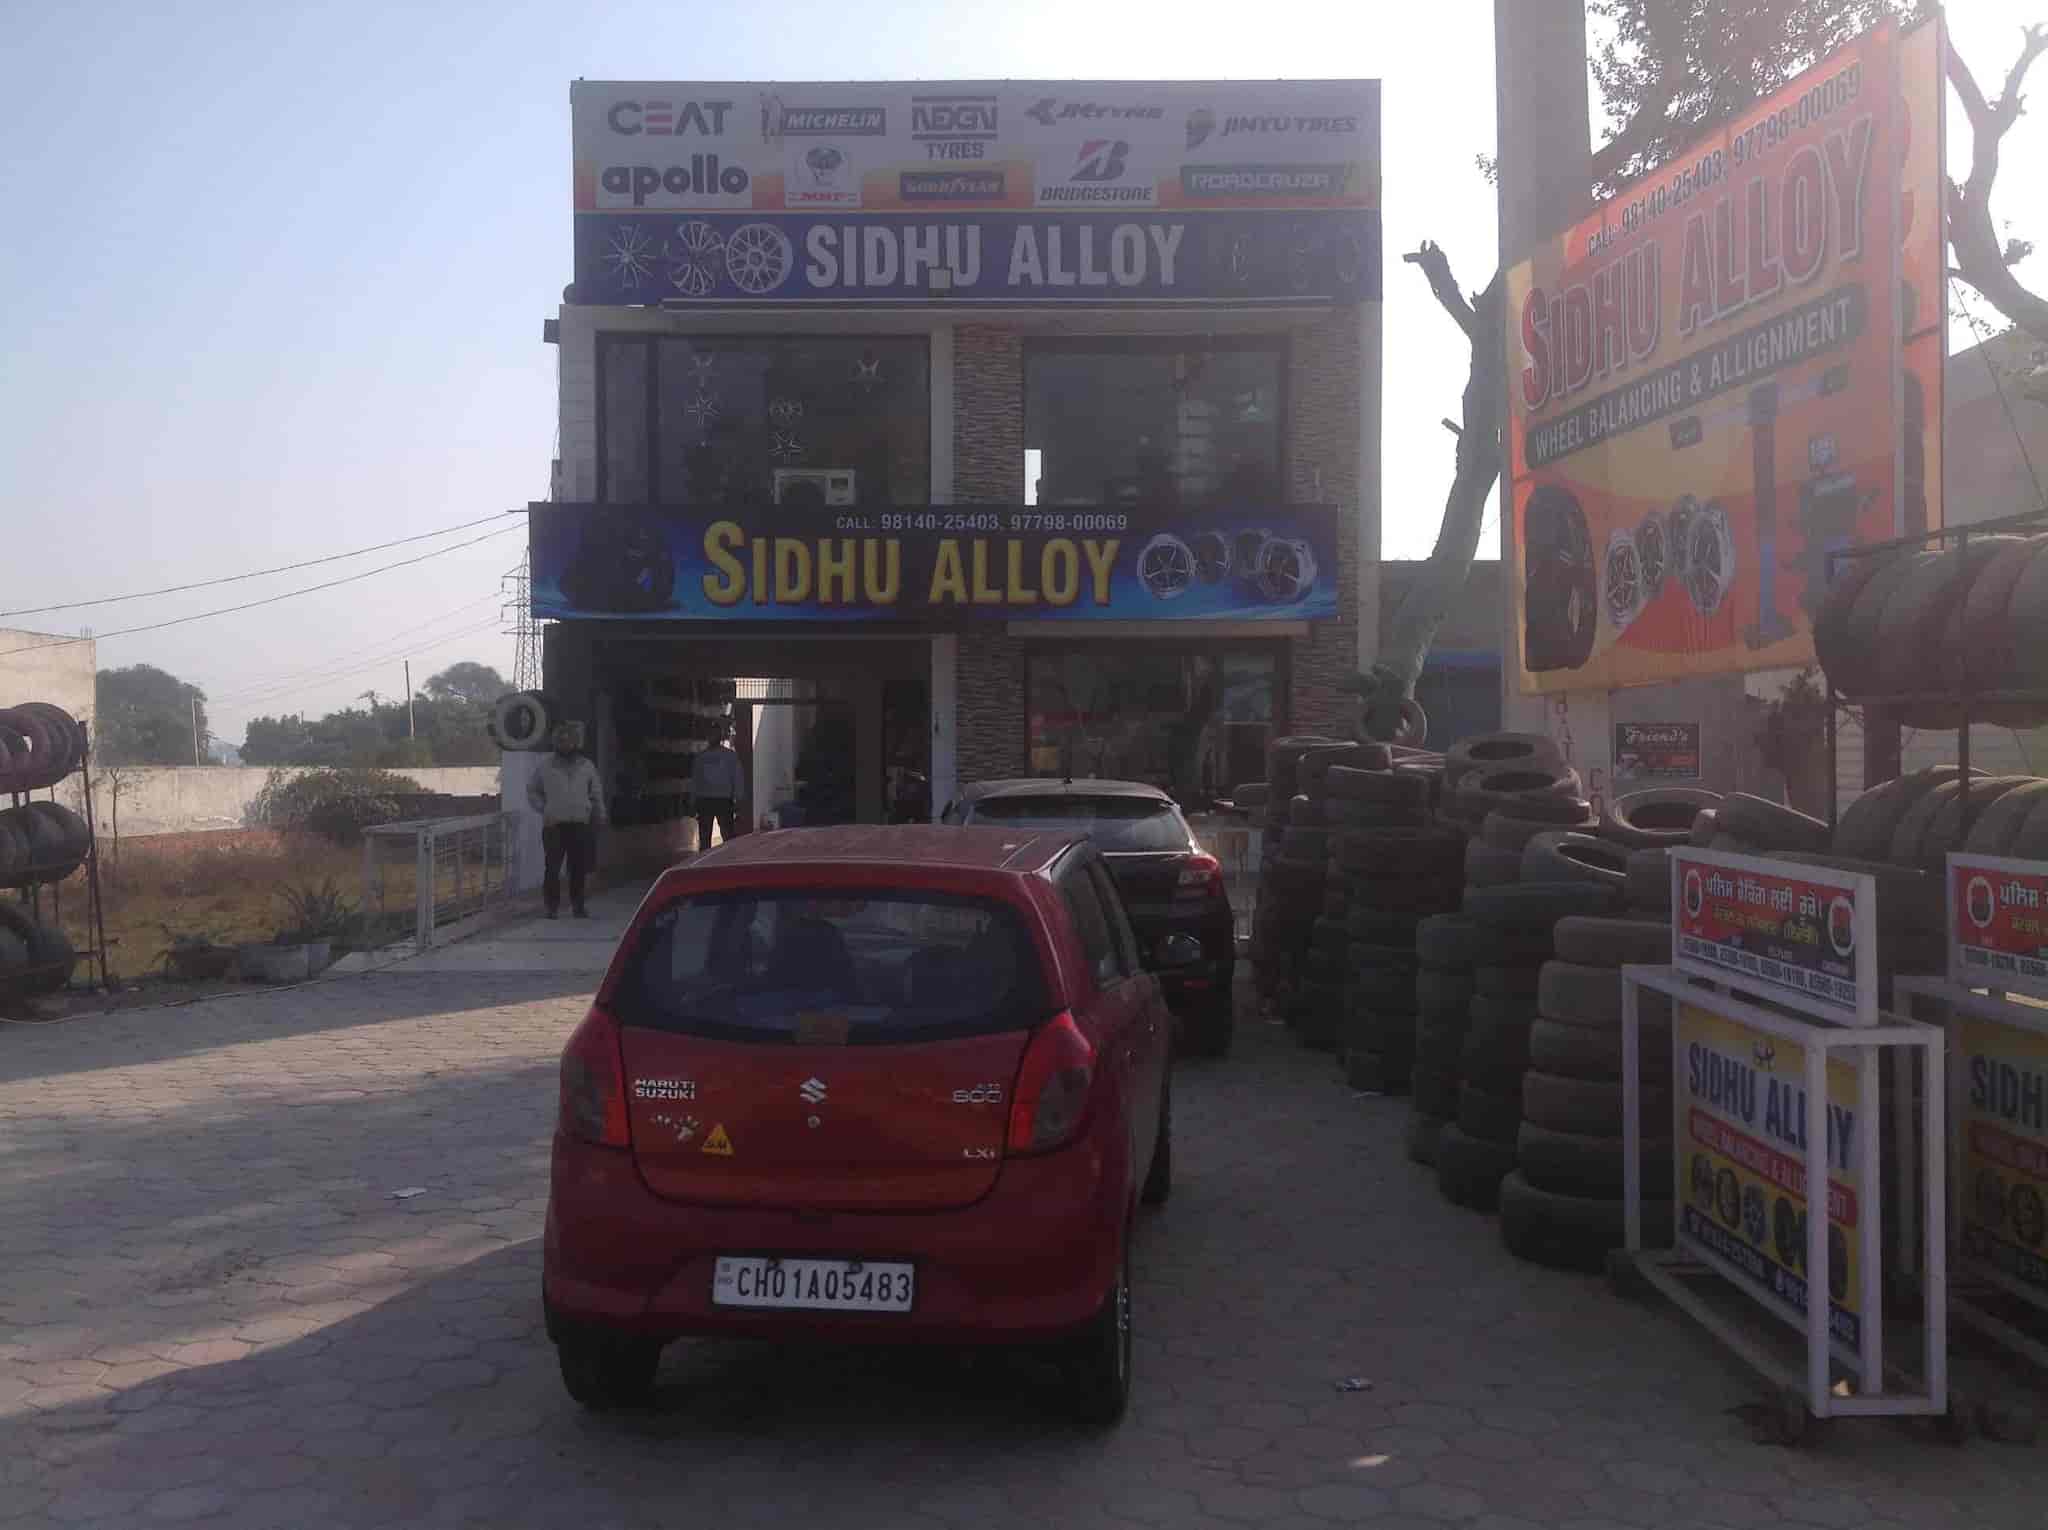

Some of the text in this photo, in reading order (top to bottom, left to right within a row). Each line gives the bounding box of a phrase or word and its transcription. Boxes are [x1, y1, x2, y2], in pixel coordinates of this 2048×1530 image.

[607, 101, 733, 136] CEAT
[787, 111, 881, 129] MICHELIN
[601, 153, 749, 206] apollo
[1039, 186, 1153, 202] BRIDGESTONE
[804, 222, 1185, 288] SIDHU ALLOY
[1519, 112, 1874, 411] SIDHU ALLOY
[1535, 297, 1852, 460] WHEEL BALANCING & ALLIGNMENT
[1010, 514, 1128, 530] 97798-00069
[702, 520, 1120, 606] SIDHU ALLOY
[634, 1079, 696, 1089] MARUTI
[634, 1087, 696, 1101] SUZUKI
[1687, 1042, 1756, 1123] SIDHU
[1971, 1054, 2048, 1131] SIDH
[736, 1266, 912, 1303] CH01AQ5483
